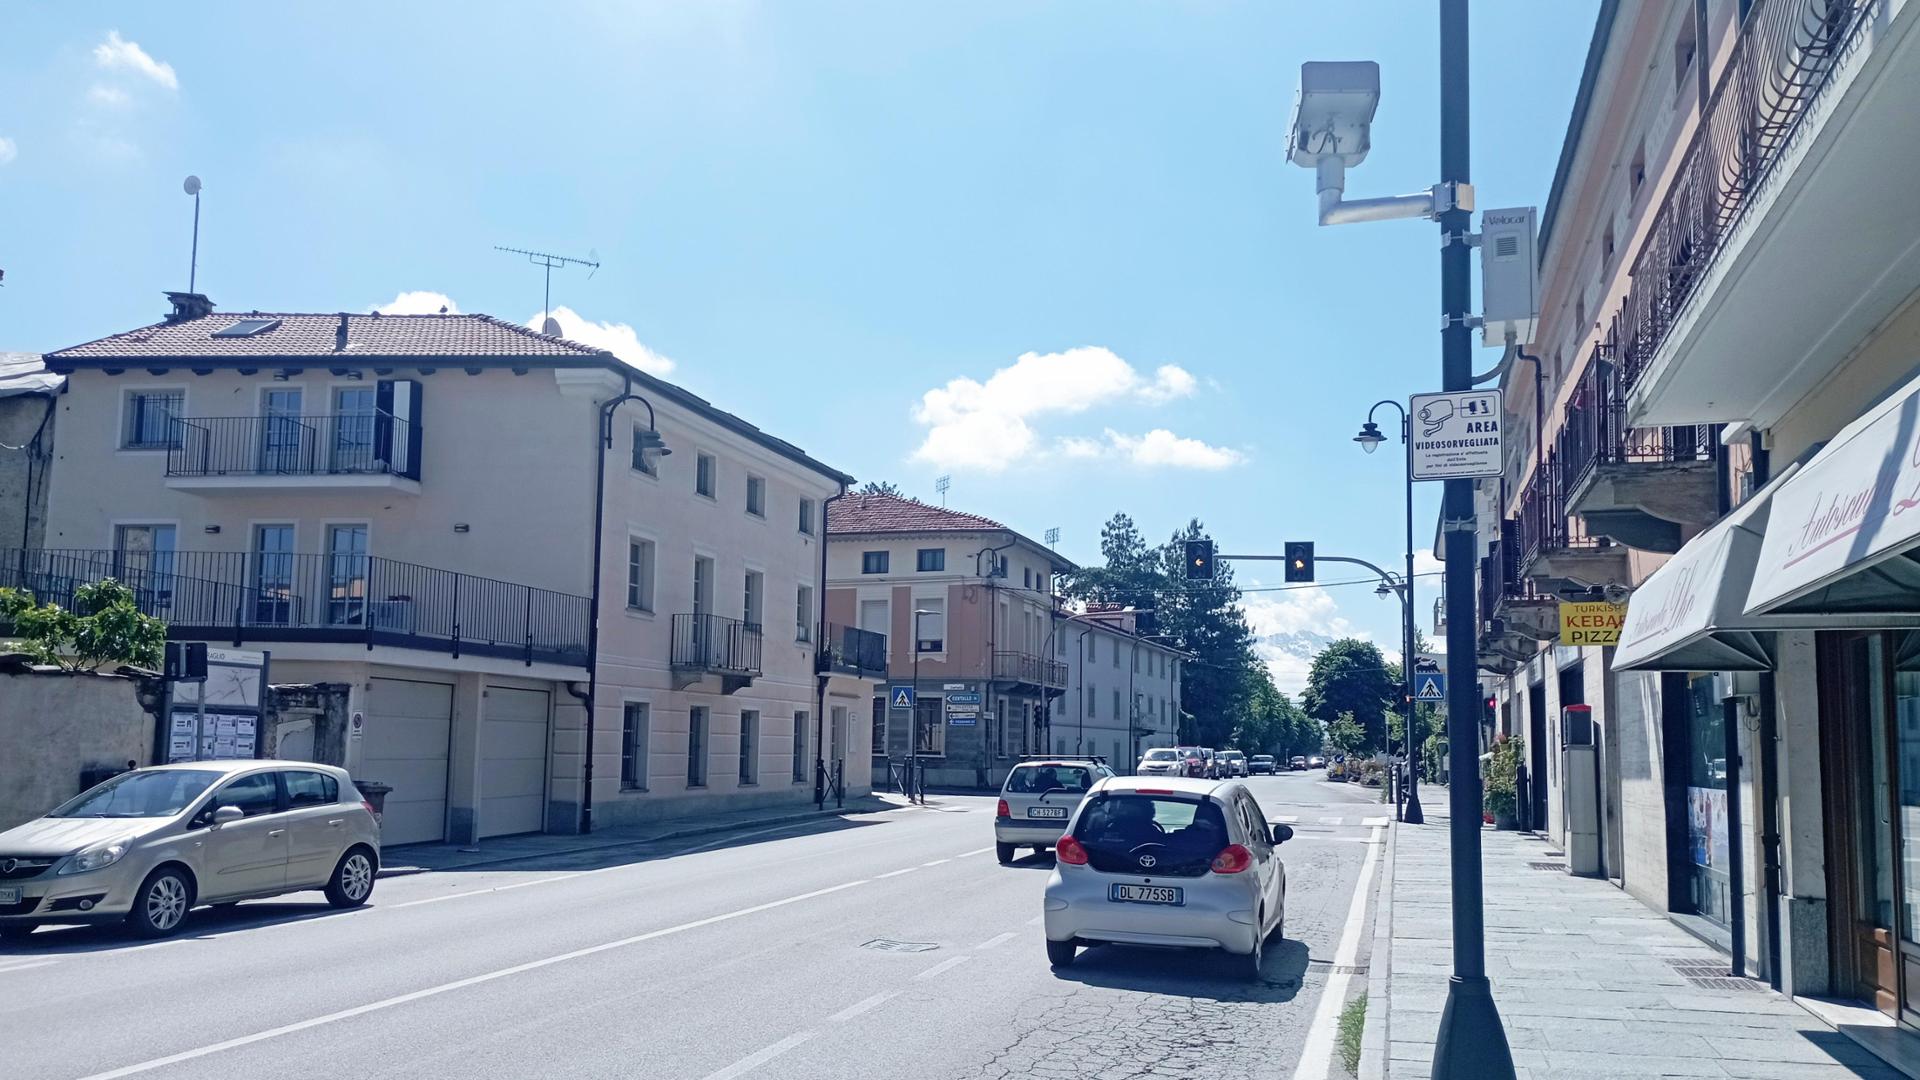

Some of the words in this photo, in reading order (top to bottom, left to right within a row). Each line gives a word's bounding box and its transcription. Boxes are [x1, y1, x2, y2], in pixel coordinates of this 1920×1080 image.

[1488, 215, 1525, 225] Velocar
[1466, 421, 1498, 434] AREA
[1415, 437, 1499, 450] VIDEOSORVEGLIATA
[1788, 477, 1893, 557] Autoscu
[1574, 604, 1621, 614] TURKISH
[1120, 886, 1134, 899] DL
[1138, 887, 1175, 902] 775SB
